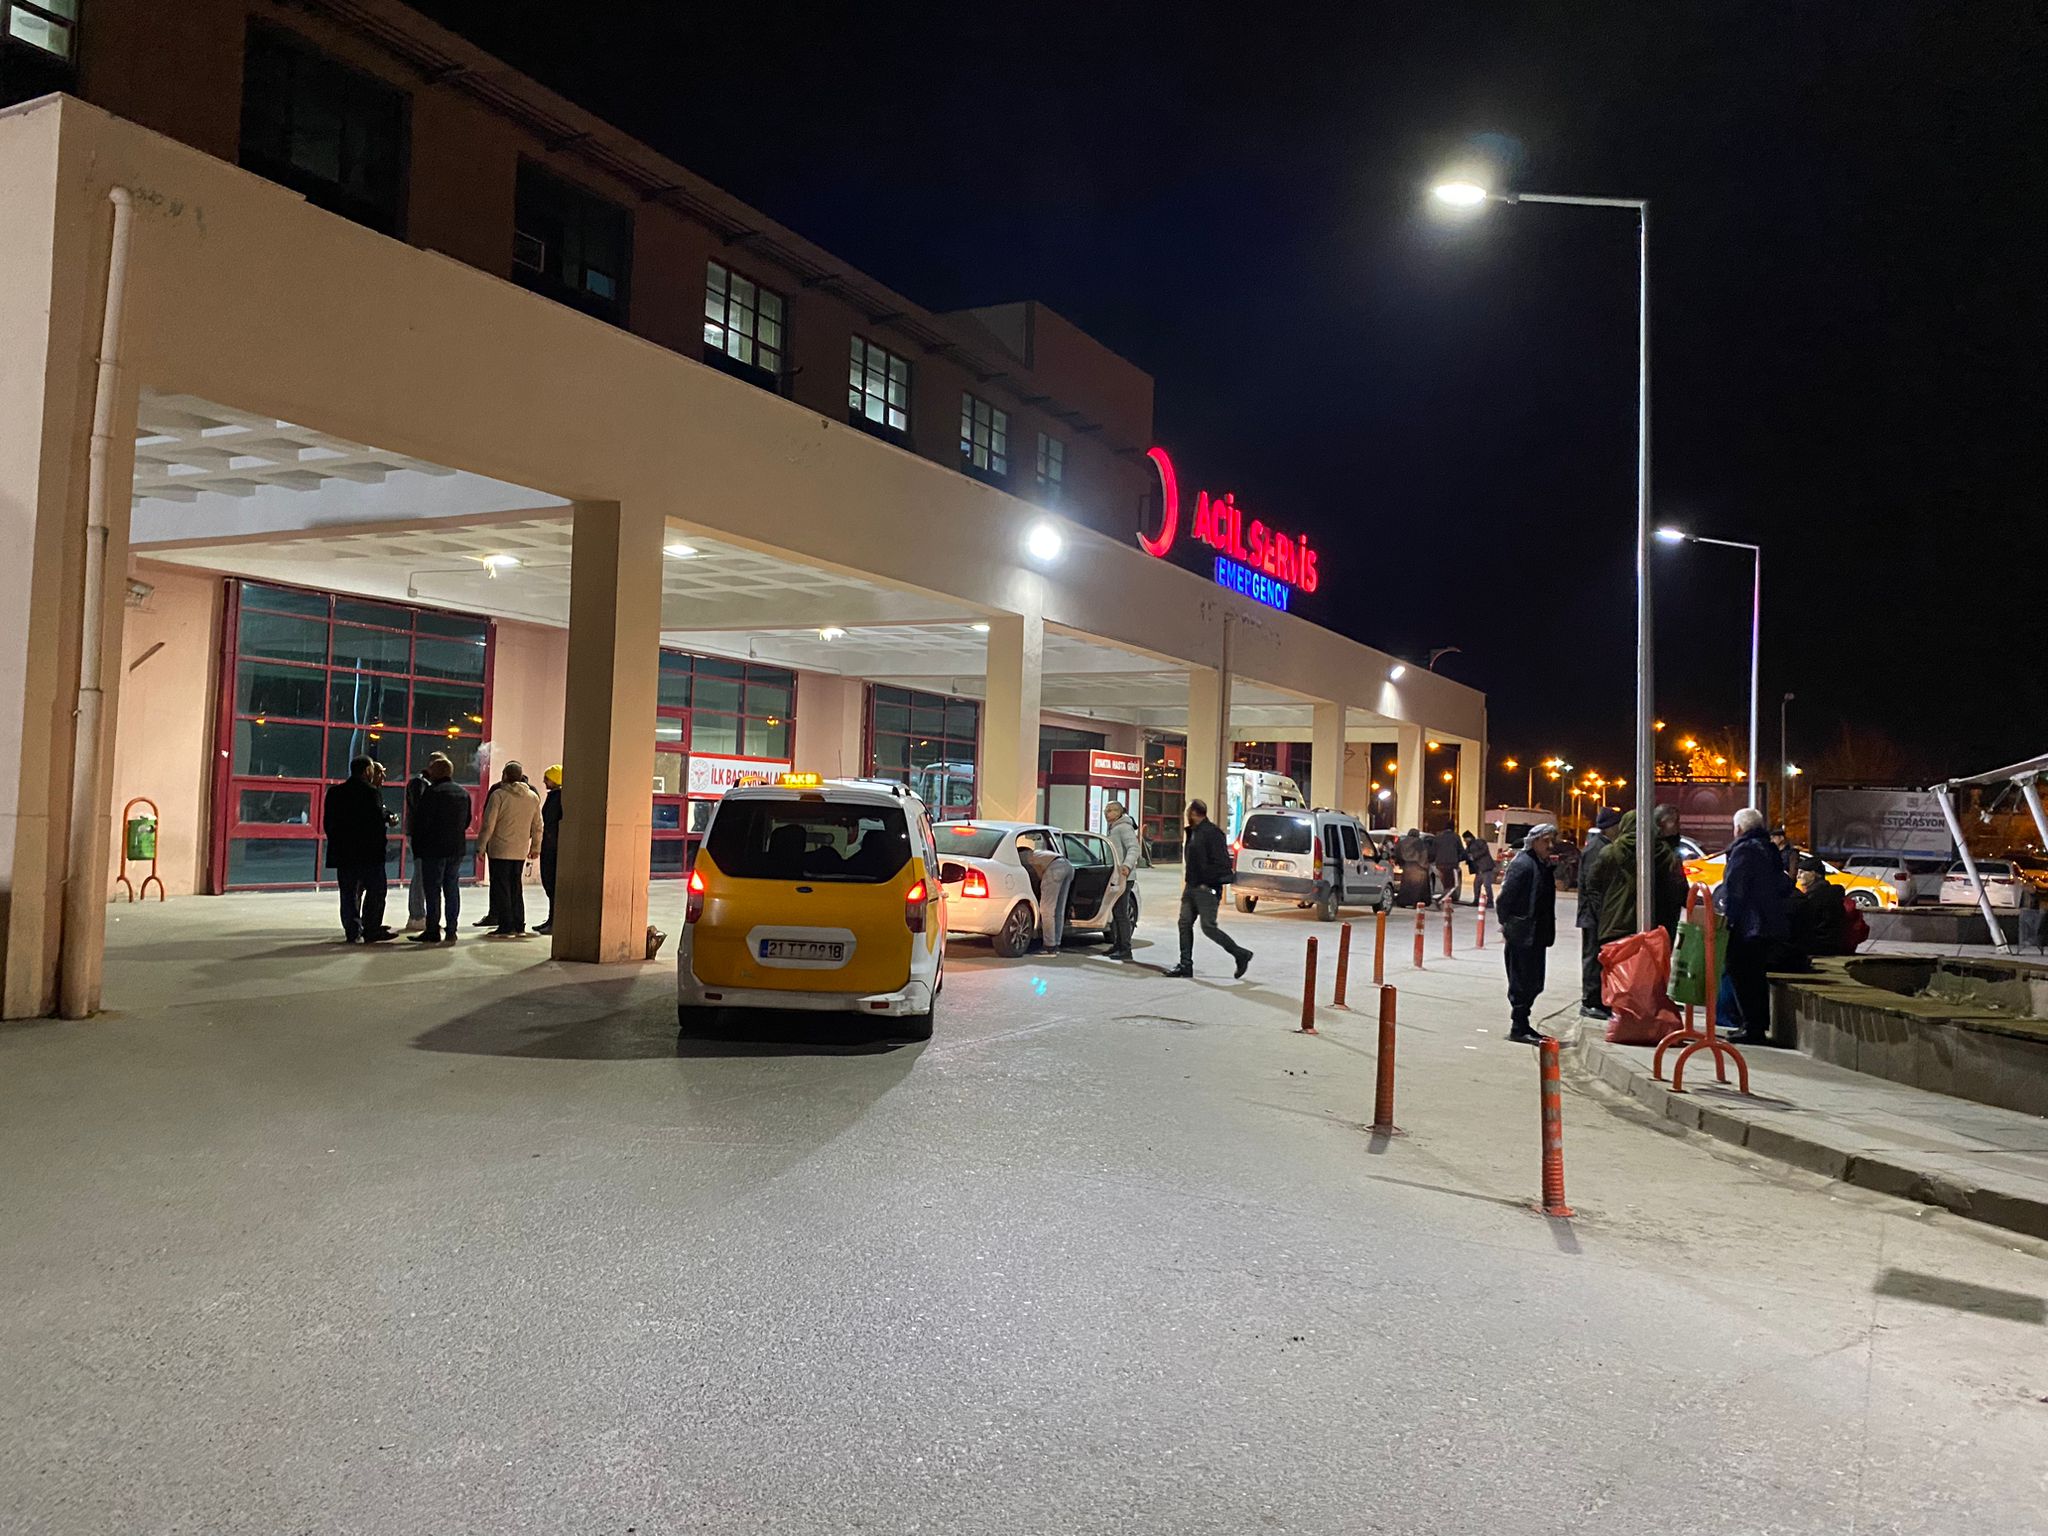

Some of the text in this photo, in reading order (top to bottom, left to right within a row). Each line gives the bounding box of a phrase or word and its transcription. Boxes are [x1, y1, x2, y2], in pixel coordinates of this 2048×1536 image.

[1192, 490, 1317, 592] ACİL SERVİS
[1216, 555, 1290, 612] EMERGENCY
[711, 764, 725, 785] İLK
[769, 942, 785, 956] 21
[788, 943, 807, 957] TT
